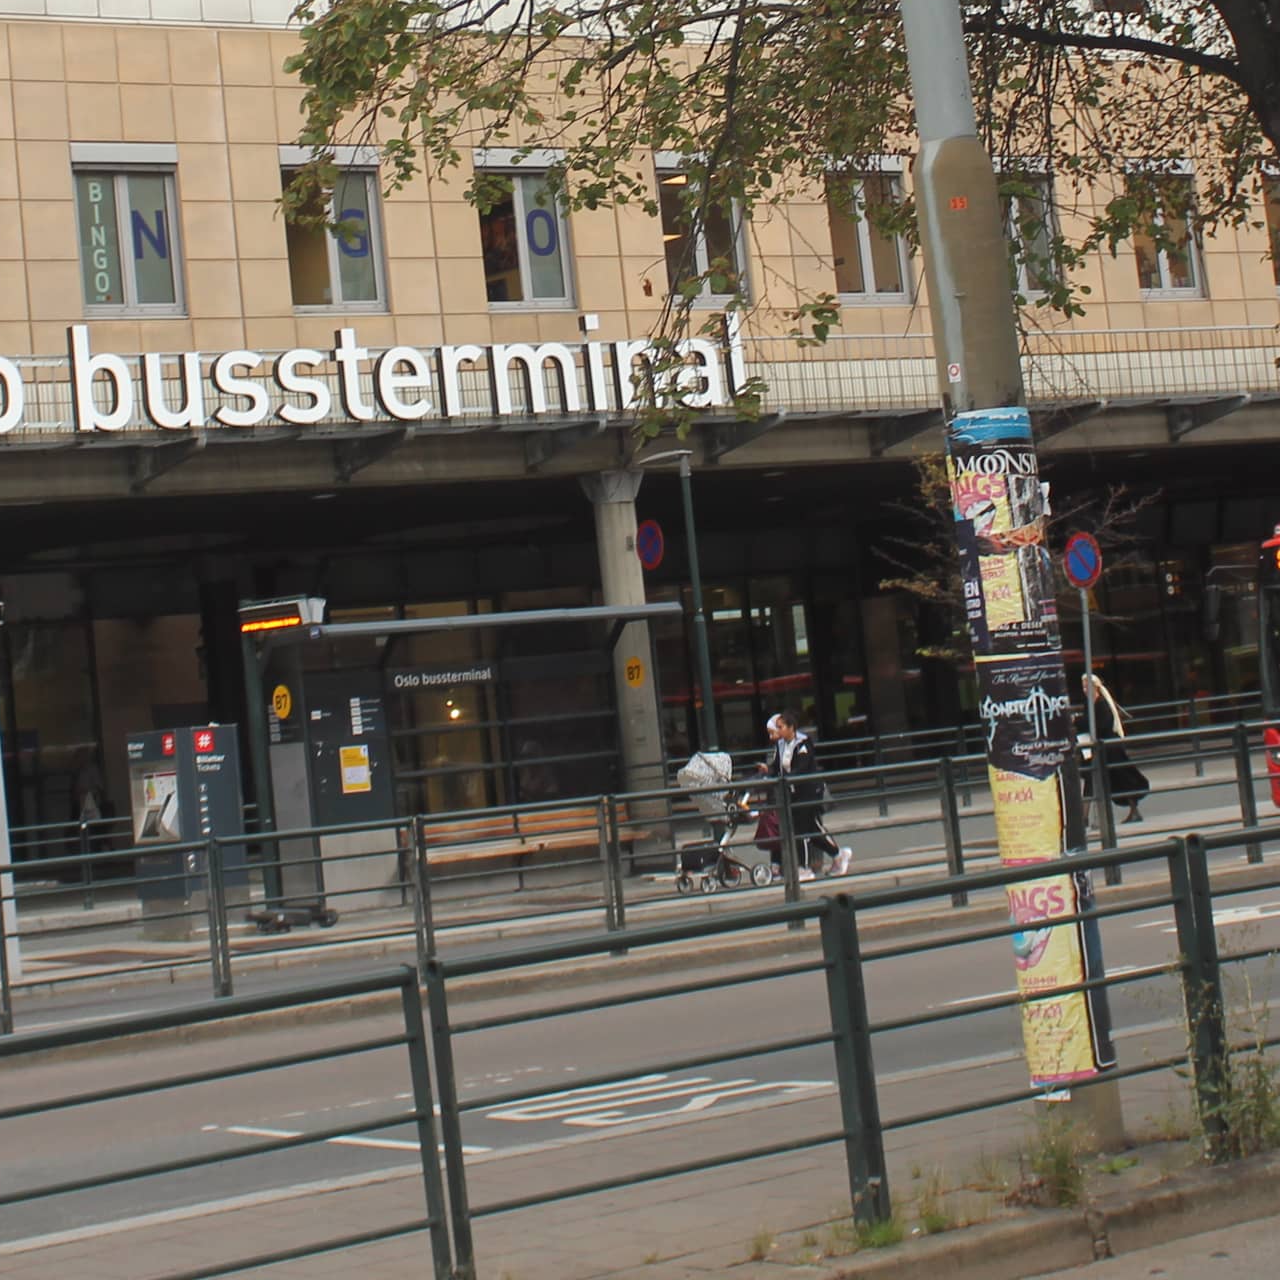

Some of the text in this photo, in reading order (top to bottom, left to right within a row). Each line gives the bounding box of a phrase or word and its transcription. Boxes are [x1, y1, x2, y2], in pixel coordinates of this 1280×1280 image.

[87, 182, 111, 293] BINGO
[131, 208, 168, 260] N
[68, 311, 744, 432] bussterminal
[394, 667, 492, 688] Oslo bussterminal
[628, 664, 642, 681] B7
[274, 693, 290, 712] B7
